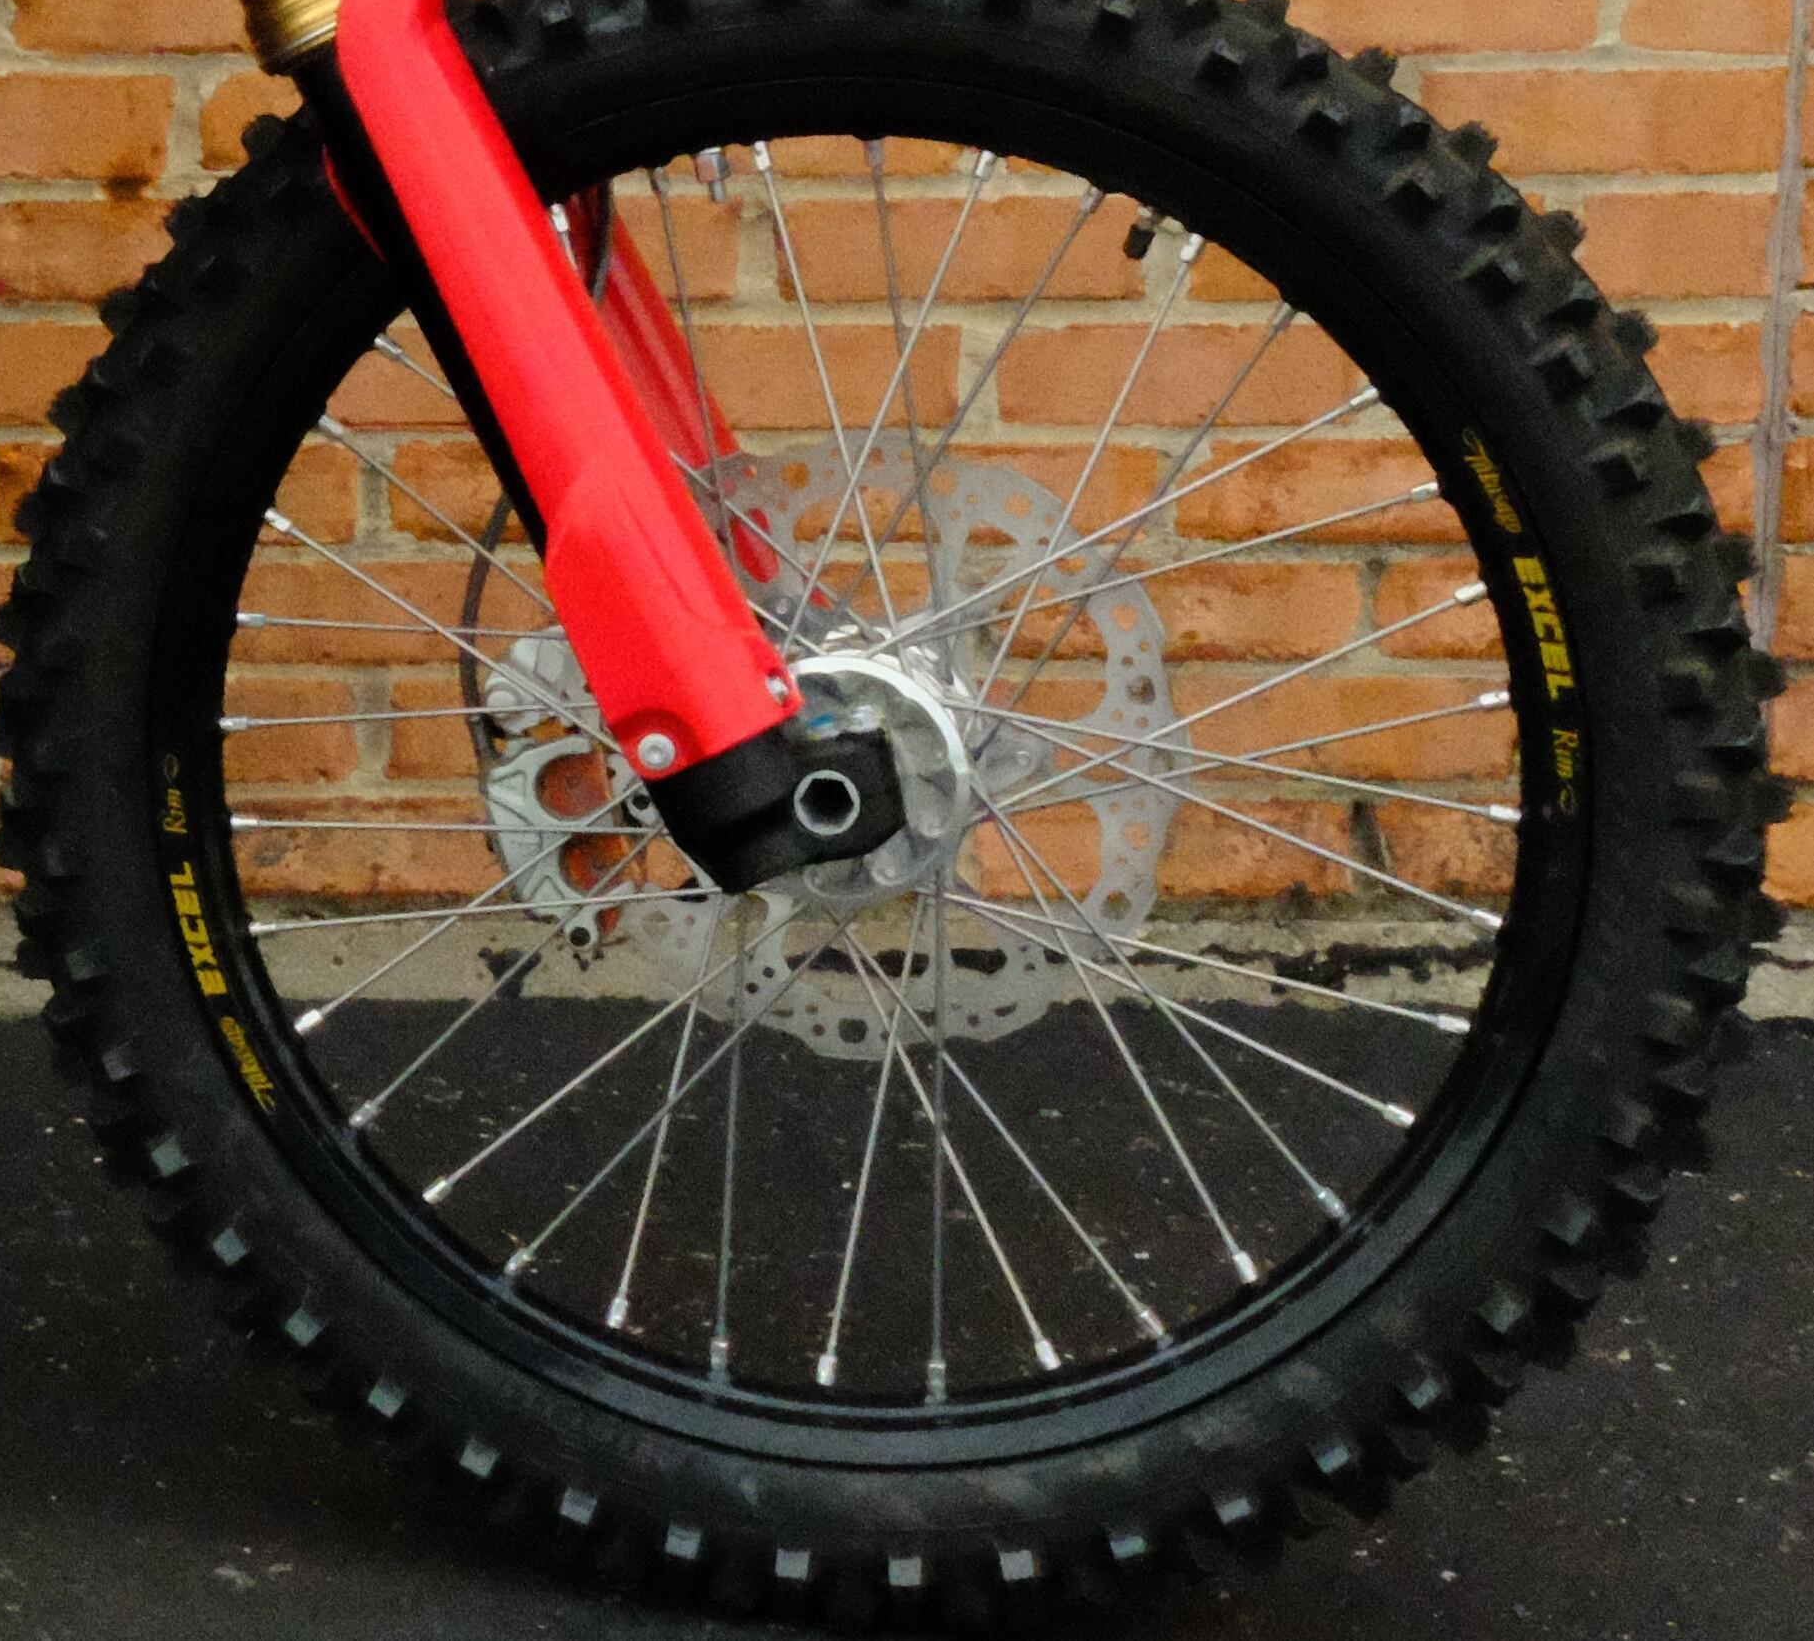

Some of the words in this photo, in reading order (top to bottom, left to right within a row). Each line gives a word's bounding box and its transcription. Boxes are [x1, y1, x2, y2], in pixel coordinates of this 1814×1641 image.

[1512, 555, 1575, 702] EXCEL
[163, 786, 189, 837] Rim
[169, 860, 229, 998] EXCEL
